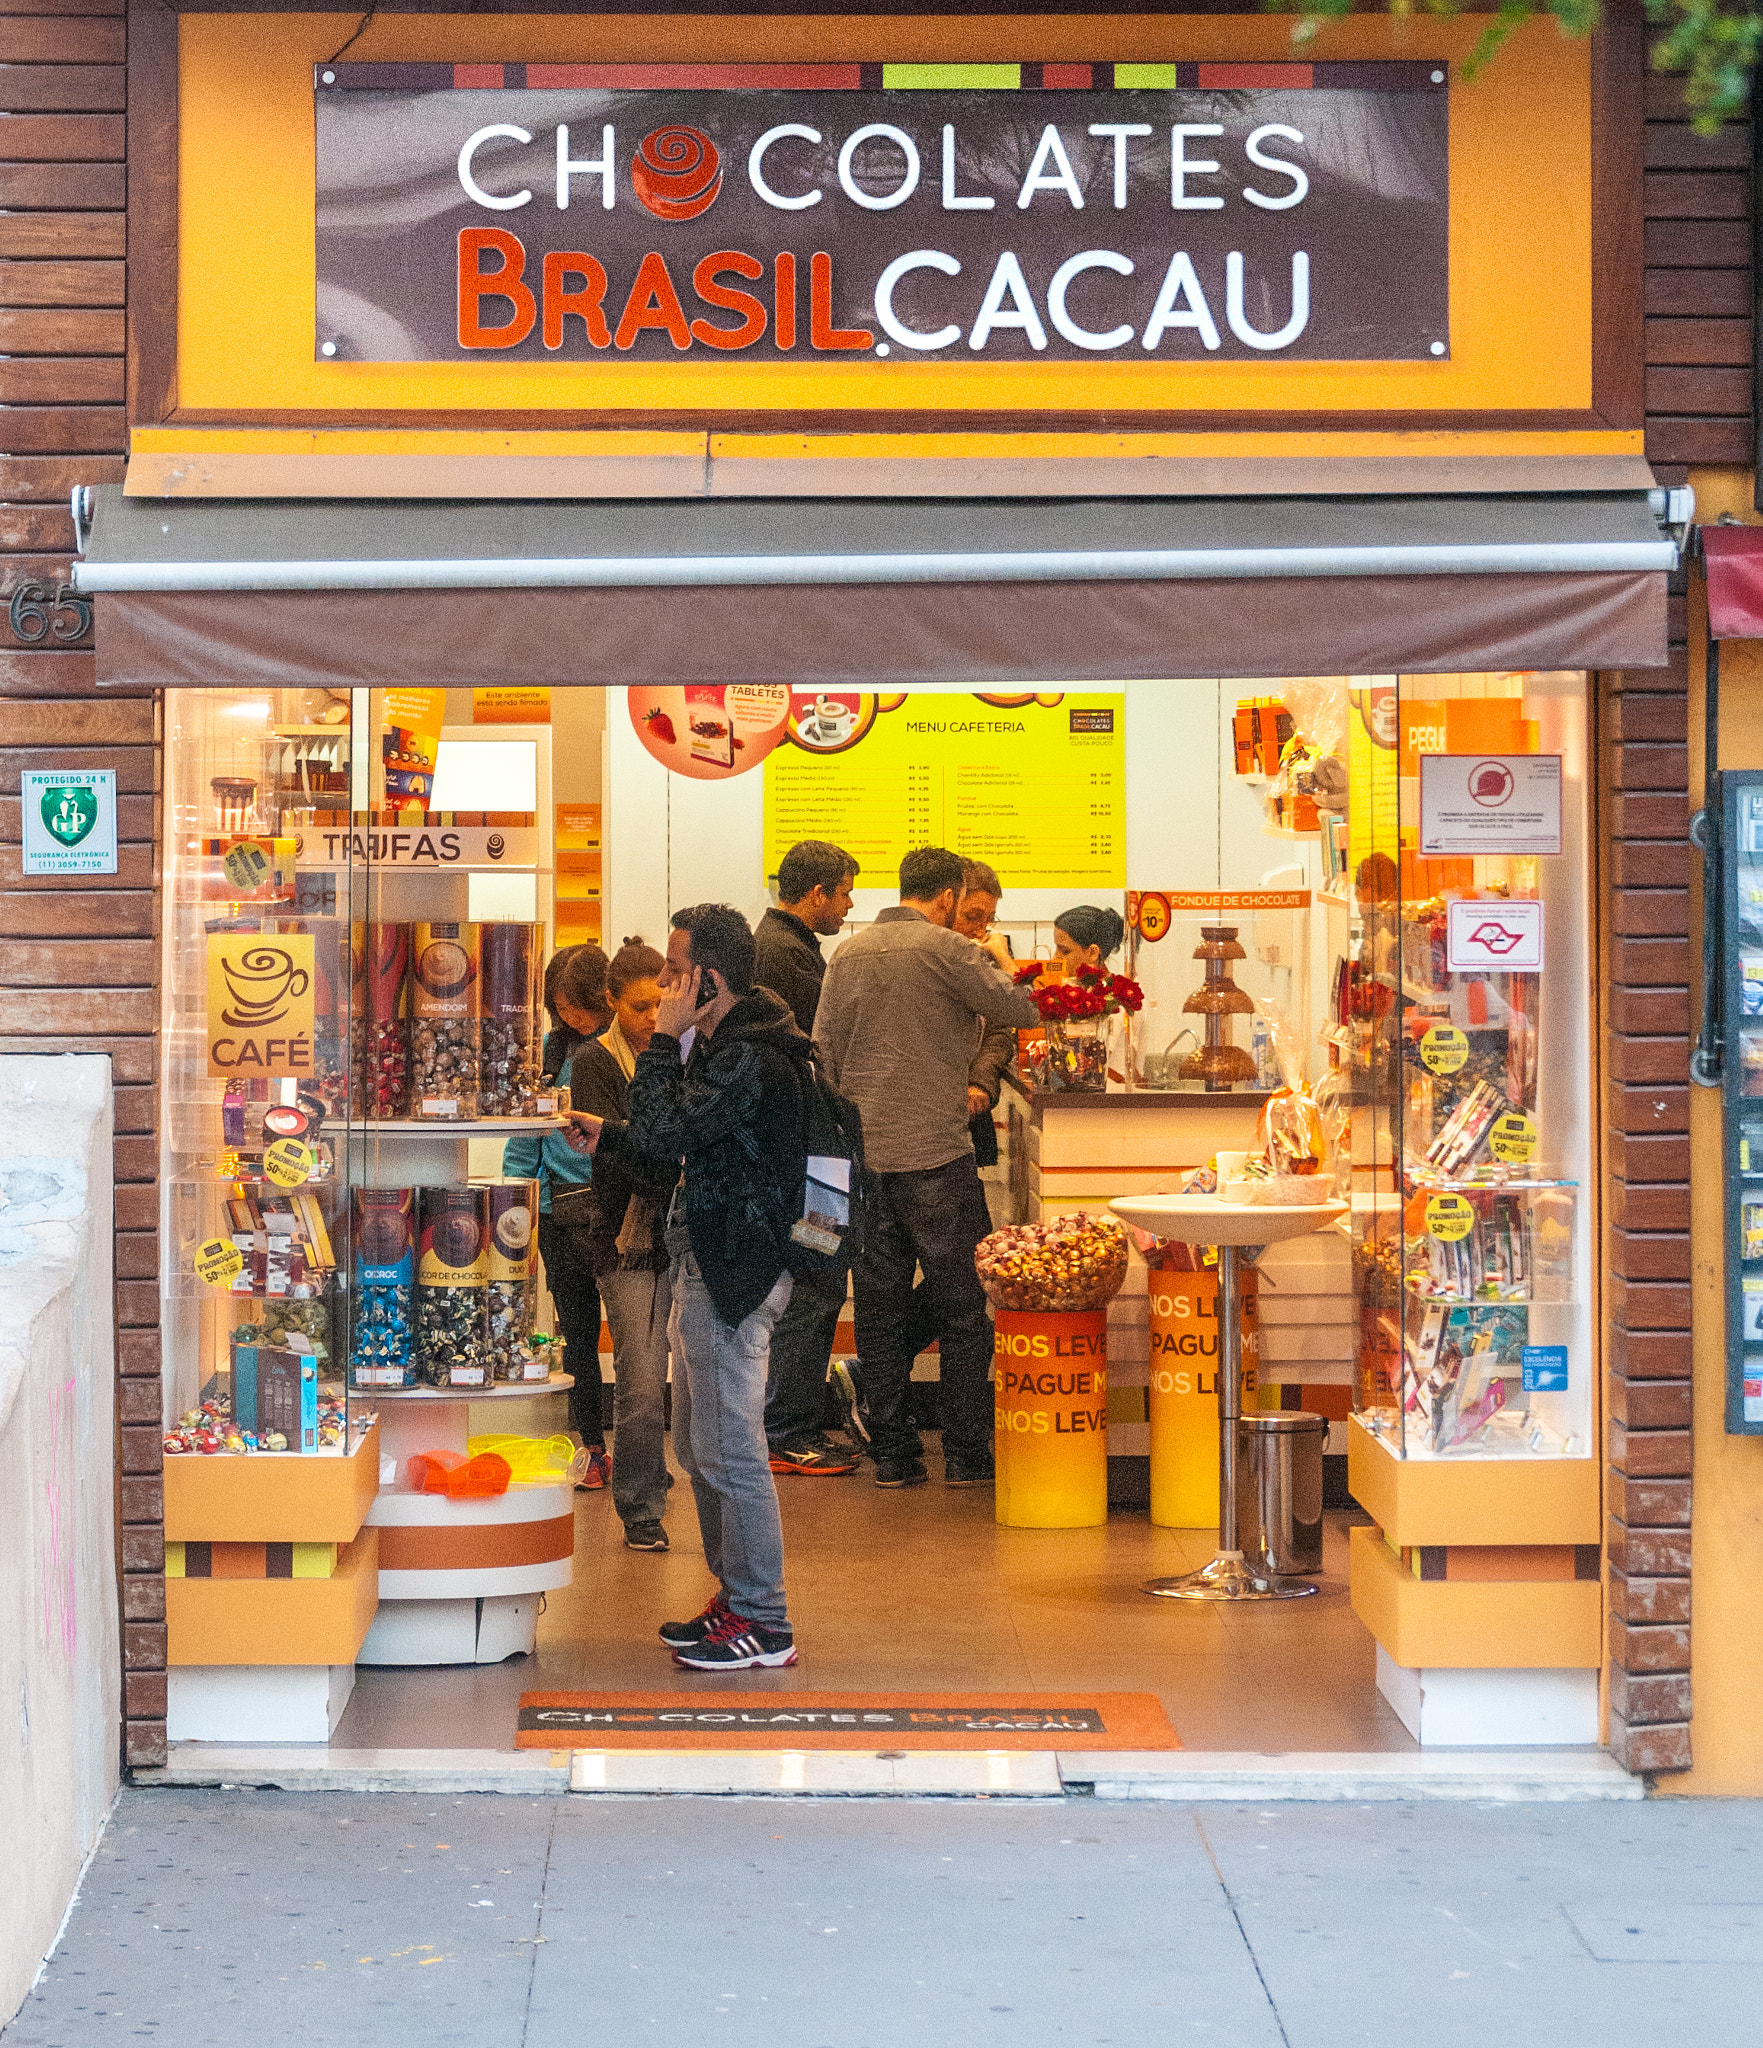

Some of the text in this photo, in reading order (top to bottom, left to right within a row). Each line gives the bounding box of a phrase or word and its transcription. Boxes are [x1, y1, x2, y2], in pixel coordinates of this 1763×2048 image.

[456, 227, 875, 352] BRASIL
[9, 582, 92, 641] 65
[731, 686, 784, 699] TABLETES
[906, 722, 1025, 732] MENU CAFETERIA
[32, 776, 106, 784] PROTEGIDO 24 H
[38, 860, 102, 869] (11) 3059-7150
[1172, 894, 1300, 906] FONDUE DE CHOCOLATE
[420, 1003, 467, 1012] AMENDOIM
[211, 1032, 309, 1067] CAFÉ
[439, 1271, 450, 1280] DE
[1152, 1332, 1218, 1356] PAGU
[1005, 1372, 1090, 1395] PAGUE
